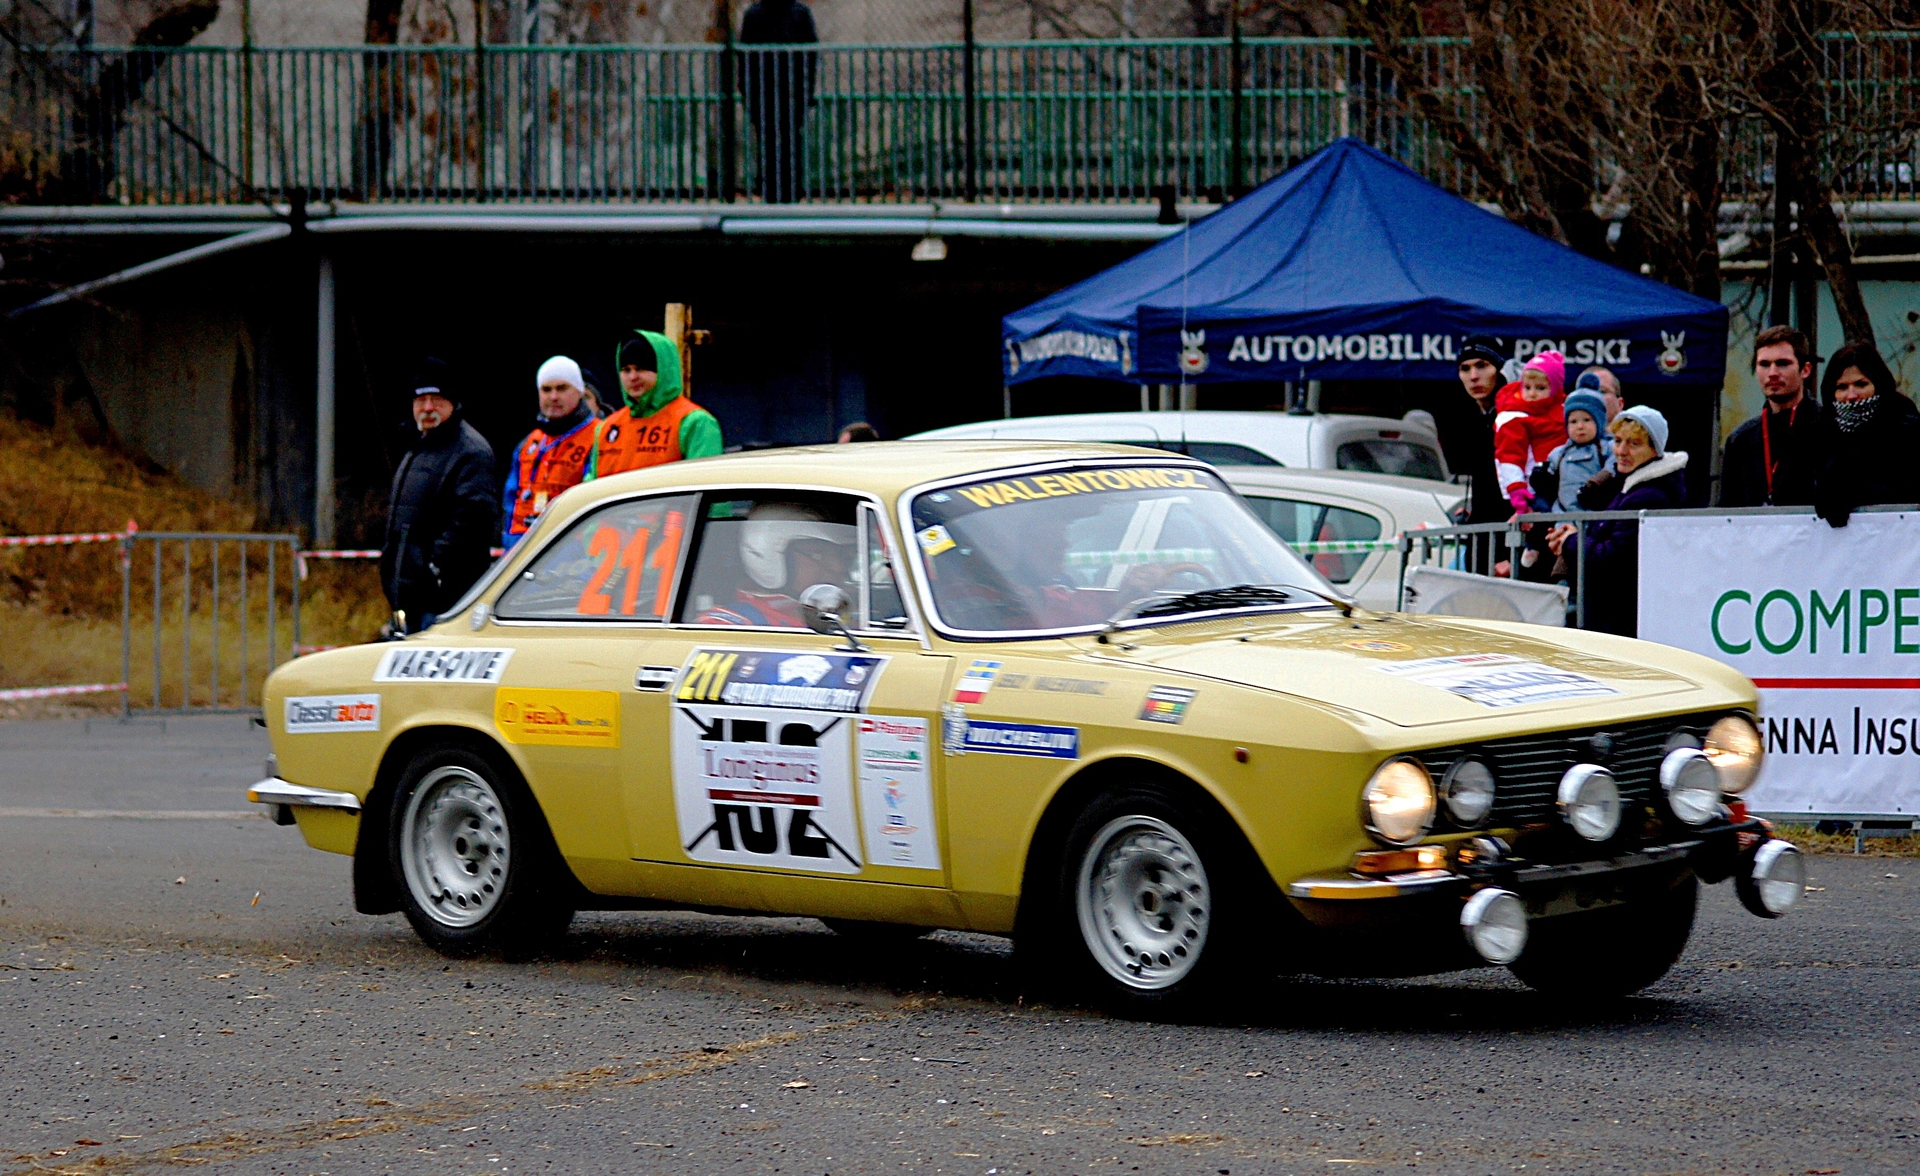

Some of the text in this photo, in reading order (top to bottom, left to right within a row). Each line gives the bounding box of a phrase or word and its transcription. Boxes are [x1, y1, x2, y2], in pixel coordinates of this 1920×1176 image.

[1228, 334, 1503, 362] AUTOMOBILKL
[637, 425, 671, 445] 161
[957, 468, 1209, 508] WALENTOWICZ
[576, 512, 684, 616] 211
[1711, 588, 1920, 655] COMPE
[386, 650, 506, 679] VARSOVIE
[677, 652, 739, 700] 211
[969, 726, 1077, 750] MICHELIN
[1756, 717, 1839, 754] NNA
[701, 747, 821, 791] Longinus
